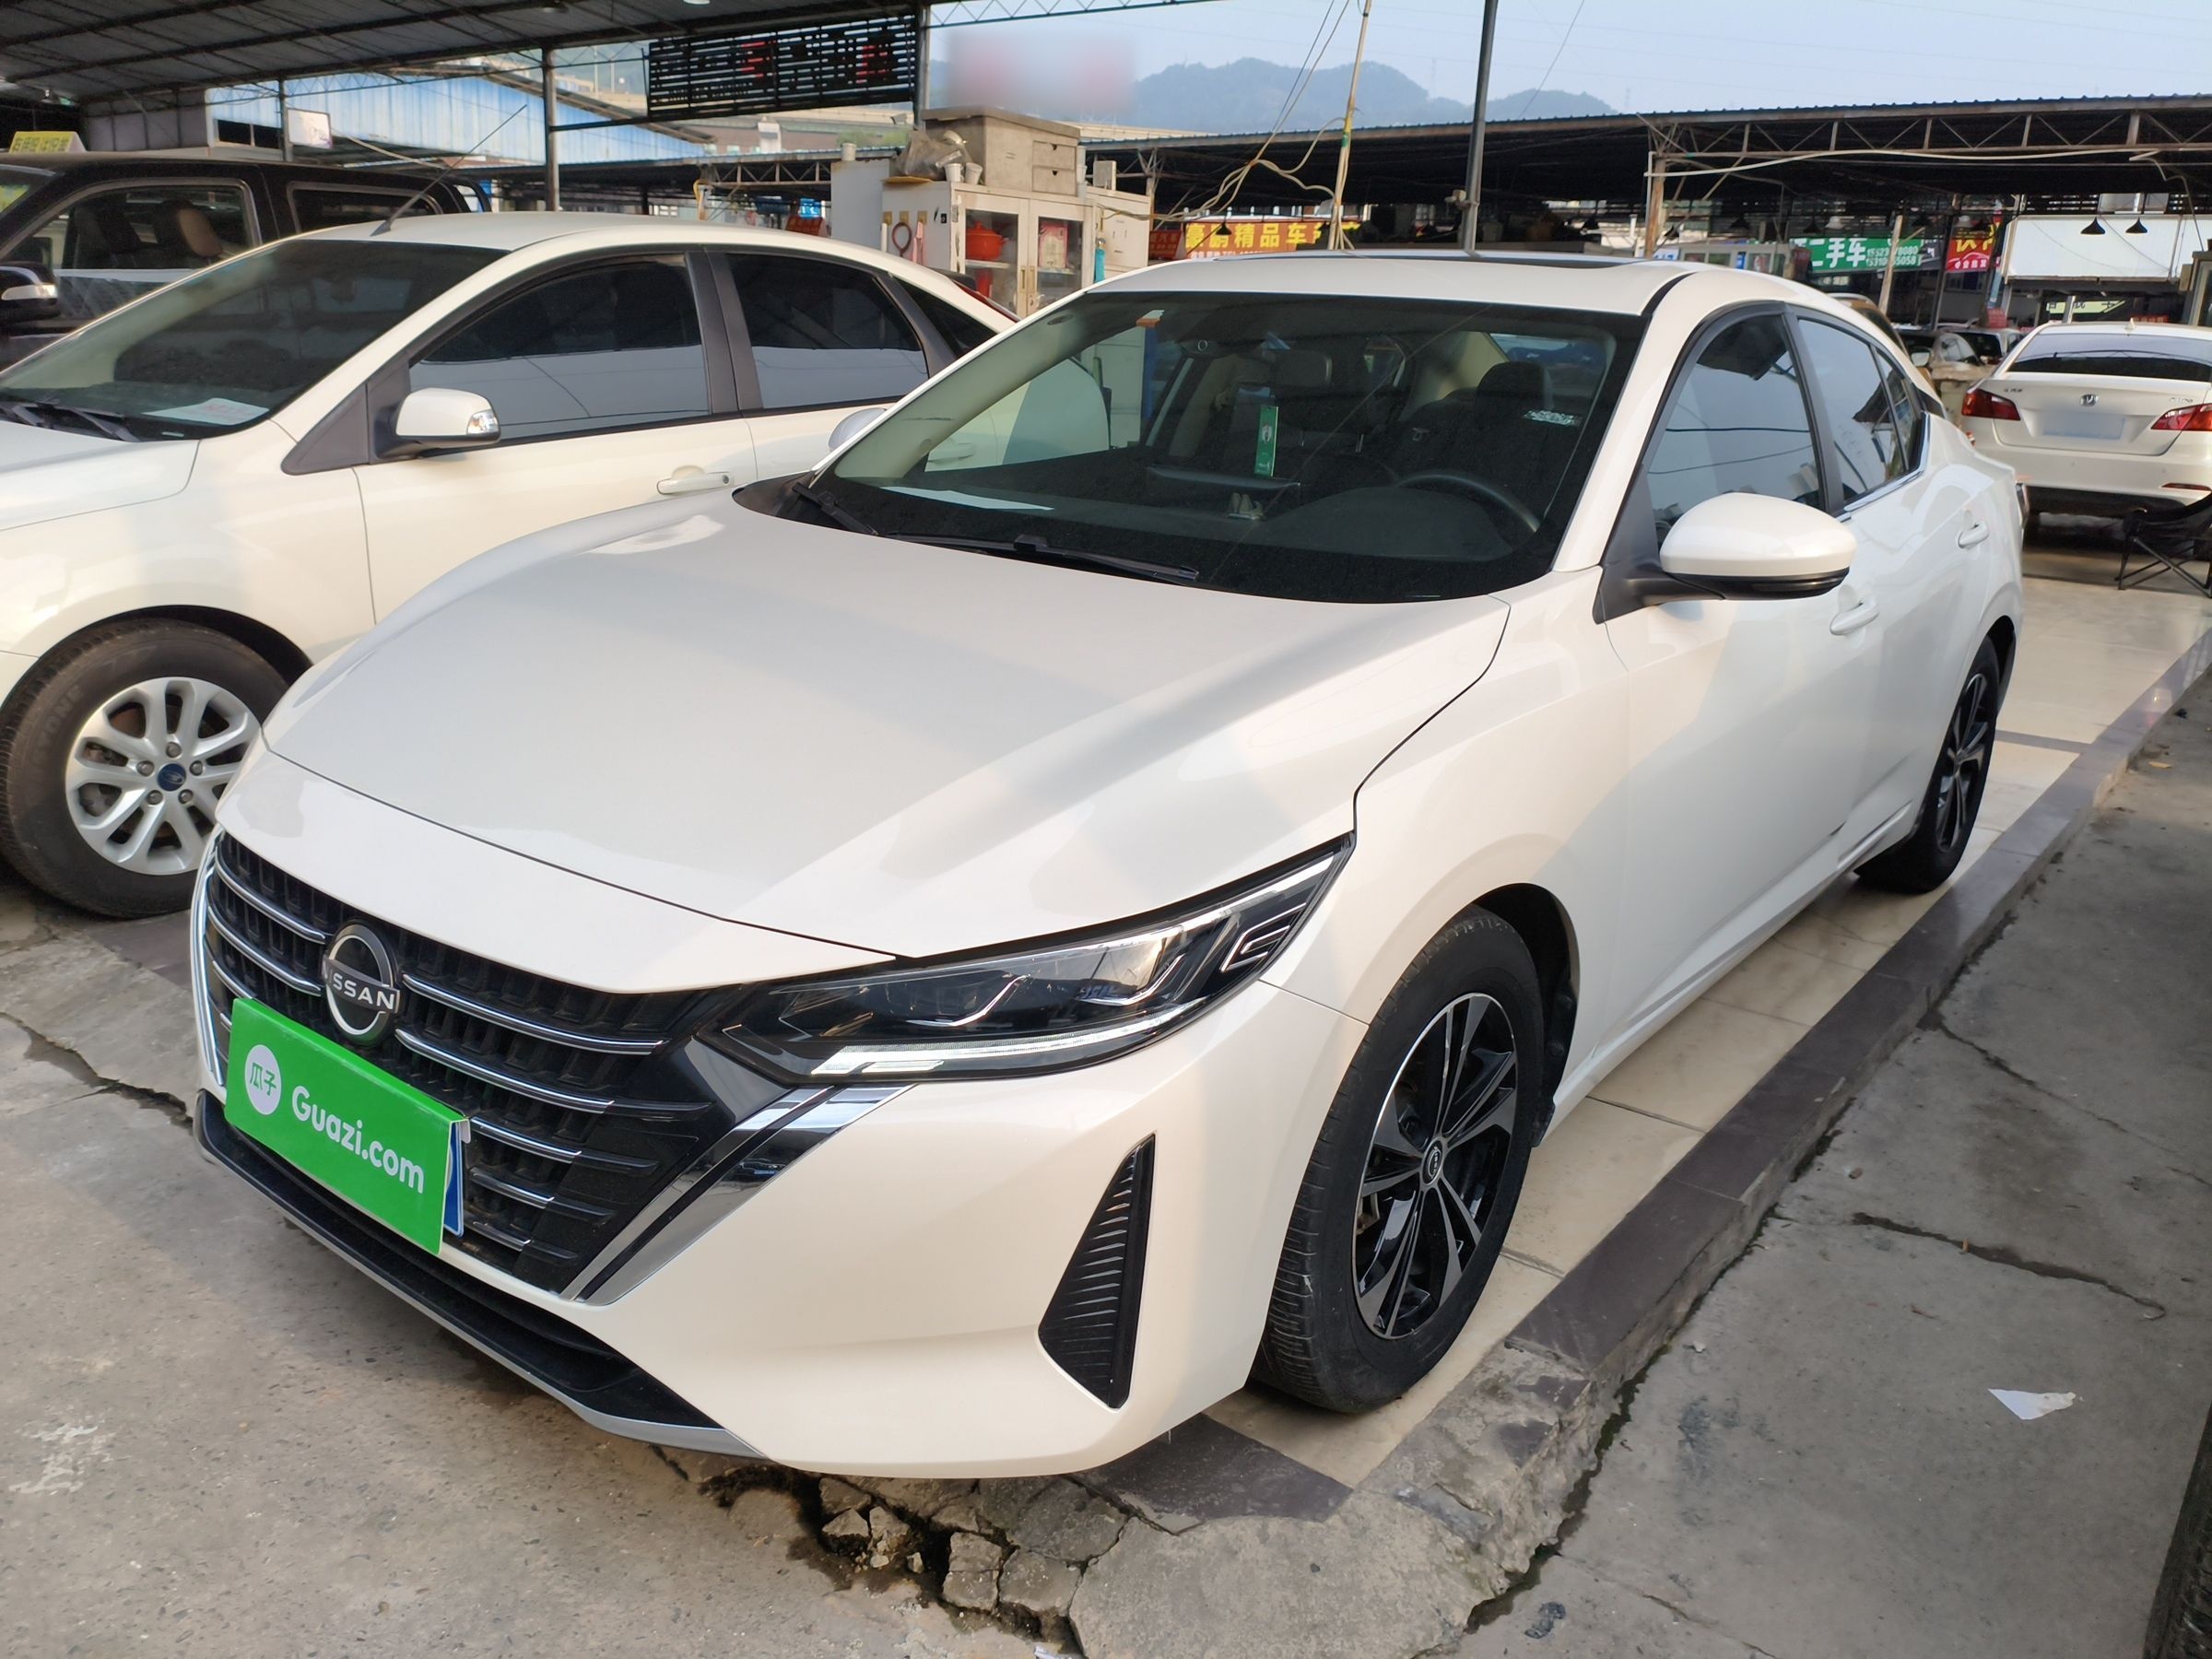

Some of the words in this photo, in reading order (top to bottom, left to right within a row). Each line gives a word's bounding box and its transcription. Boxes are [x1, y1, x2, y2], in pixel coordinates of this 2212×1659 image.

[1185, 221, 1360, 250] 豪鹏精品车
[323, 959, 395, 1011] SSAN
[250, 1062, 277, 1097] 瓜子
[291, 1085, 425, 1194] Guazi.com
